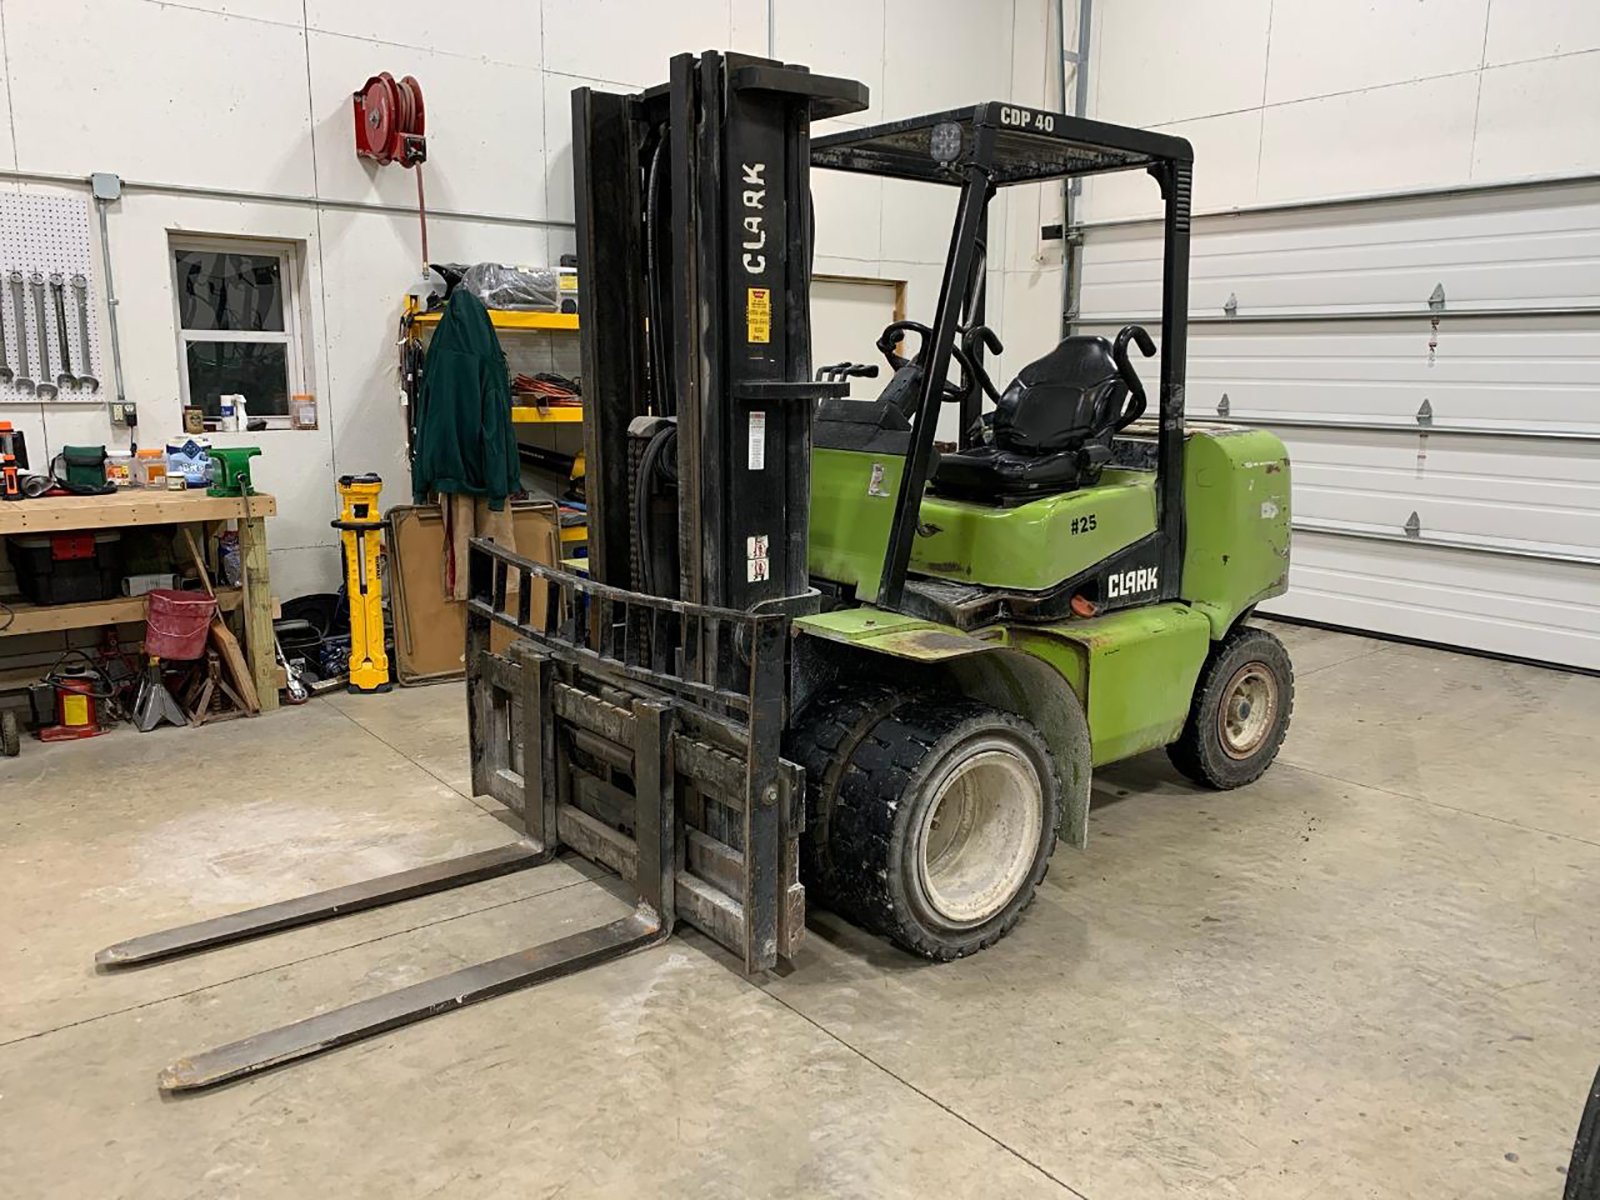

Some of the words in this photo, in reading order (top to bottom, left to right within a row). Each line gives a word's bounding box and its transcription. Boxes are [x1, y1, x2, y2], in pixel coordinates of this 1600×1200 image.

[1000, 106, 1031, 127] CDP
[1035, 113, 1055, 132] 40
[742, 163, 766, 274] CLARK
[1071, 514, 1097, 535] #25
[1108, 567, 1158, 598] CLARK
